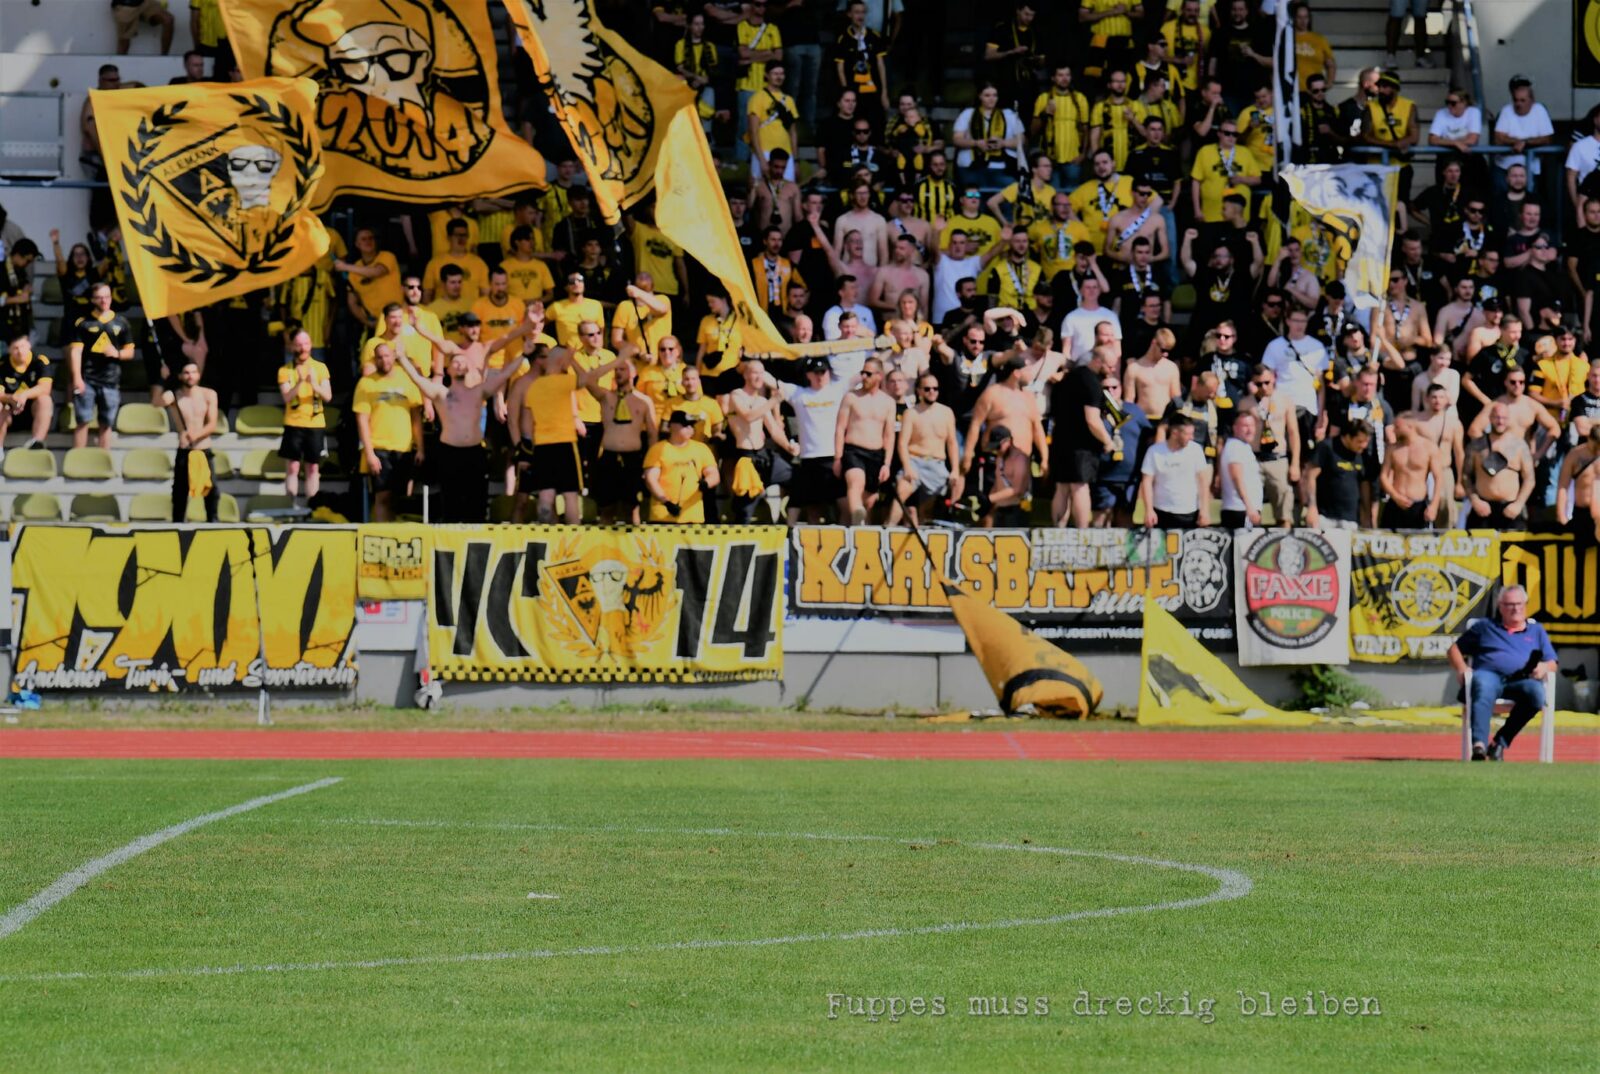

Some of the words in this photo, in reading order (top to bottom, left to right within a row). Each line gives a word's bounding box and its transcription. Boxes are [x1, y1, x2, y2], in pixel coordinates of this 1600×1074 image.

[318, 87, 478, 166] 2014
[363, 535, 422, 563] 50+1
[1409, 534, 1490, 557] STADT
[675, 543, 778, 658] 14
[1249, 572, 1334, 601] FAXE
[198, 661, 237, 686] und
